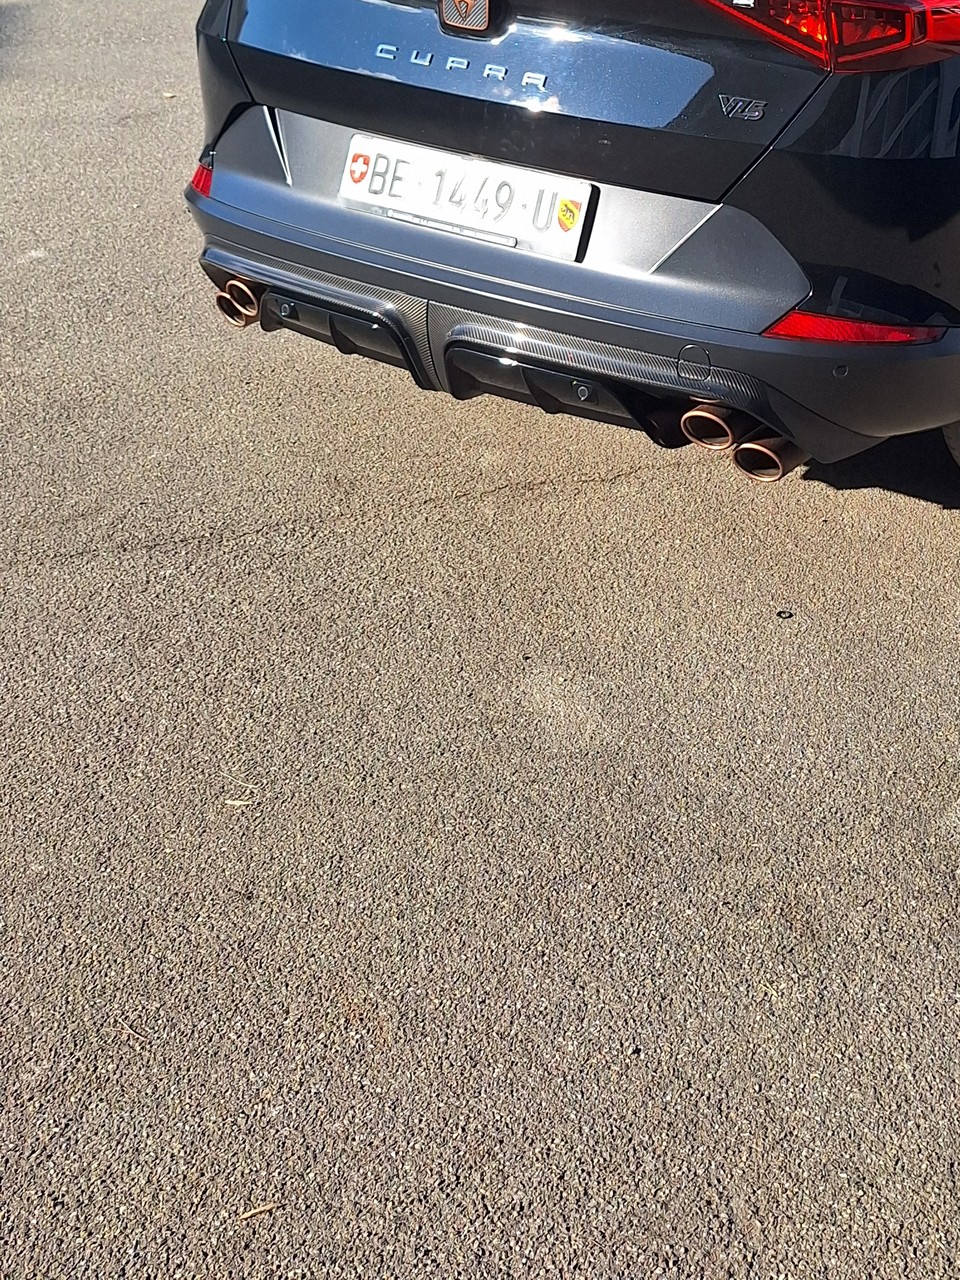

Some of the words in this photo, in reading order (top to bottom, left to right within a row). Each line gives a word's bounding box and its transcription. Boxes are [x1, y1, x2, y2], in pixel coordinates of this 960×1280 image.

[375, 43, 549, 92] CUPRA
[368, 152, 411, 198] BE
[432, 168, 516, 223] 1449
[532, 188, 559, 233] U
